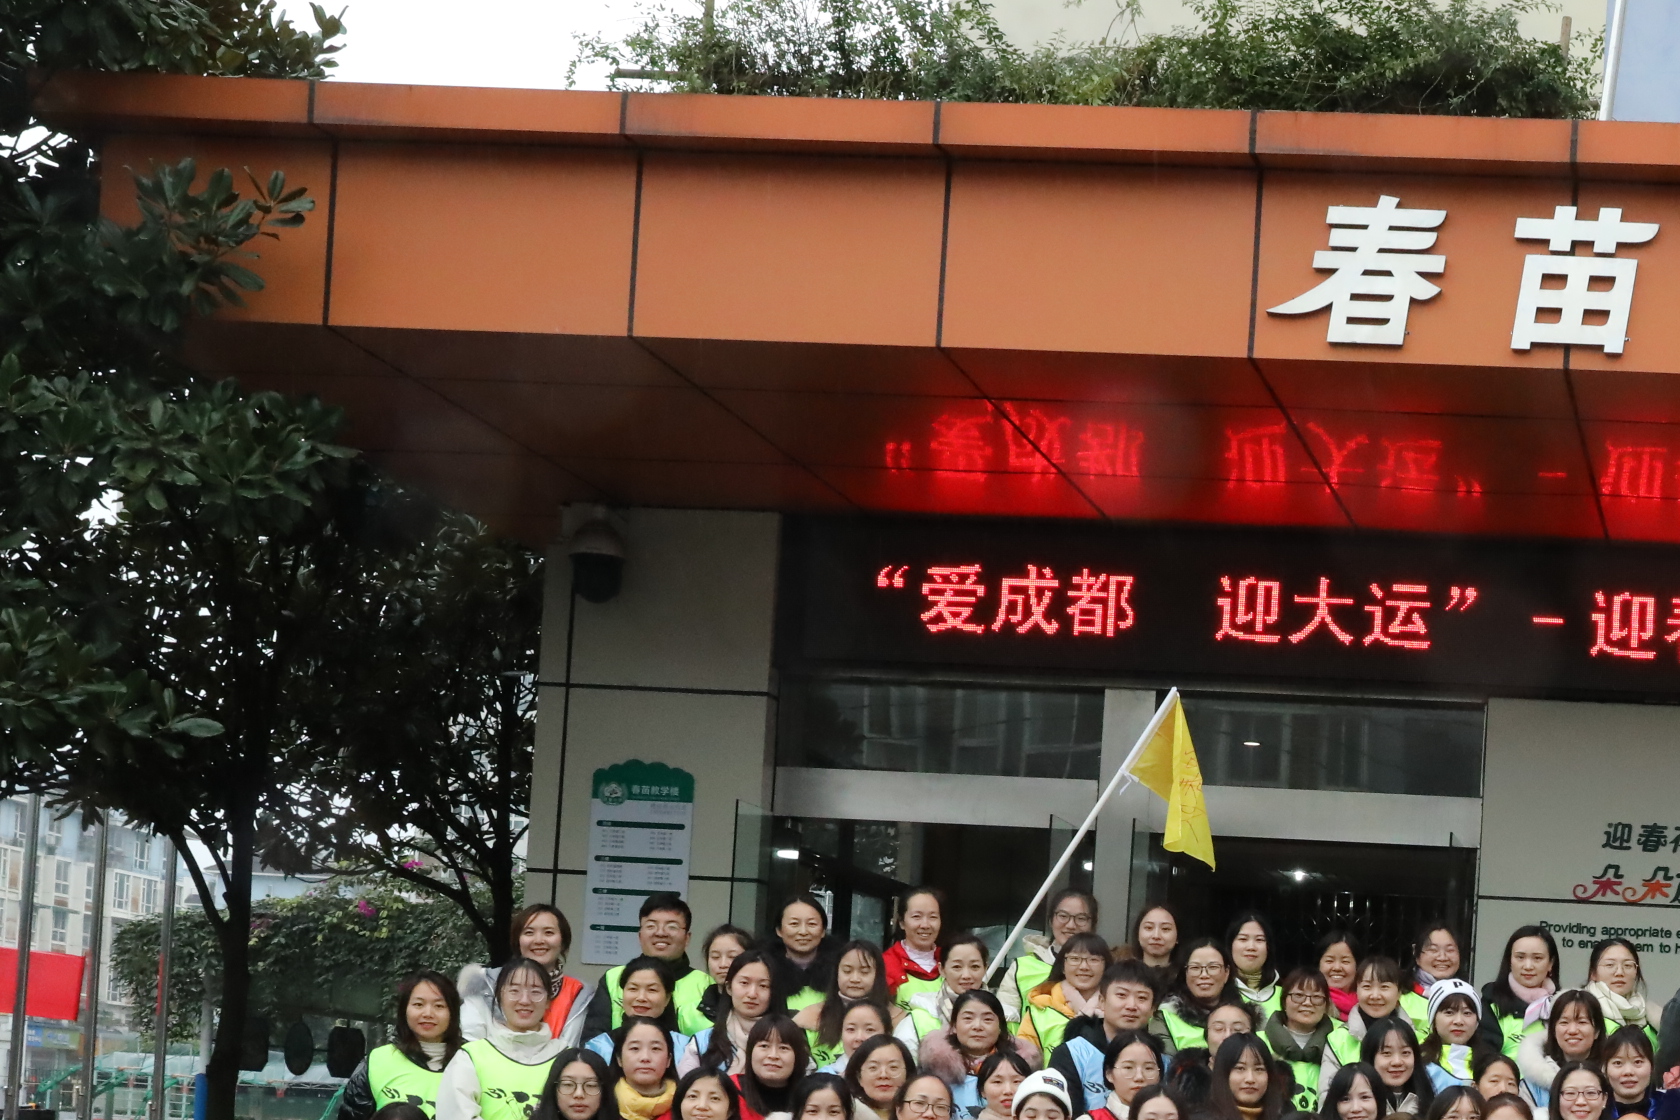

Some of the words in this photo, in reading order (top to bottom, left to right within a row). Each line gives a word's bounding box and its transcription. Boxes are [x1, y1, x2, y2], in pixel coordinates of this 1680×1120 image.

[1539, 921, 1597, 937] Providing
[1601, 926, 1672, 939] appropriate
[1562, 937, 1574, 948] to
[1659, 943, 1671, 953] to
